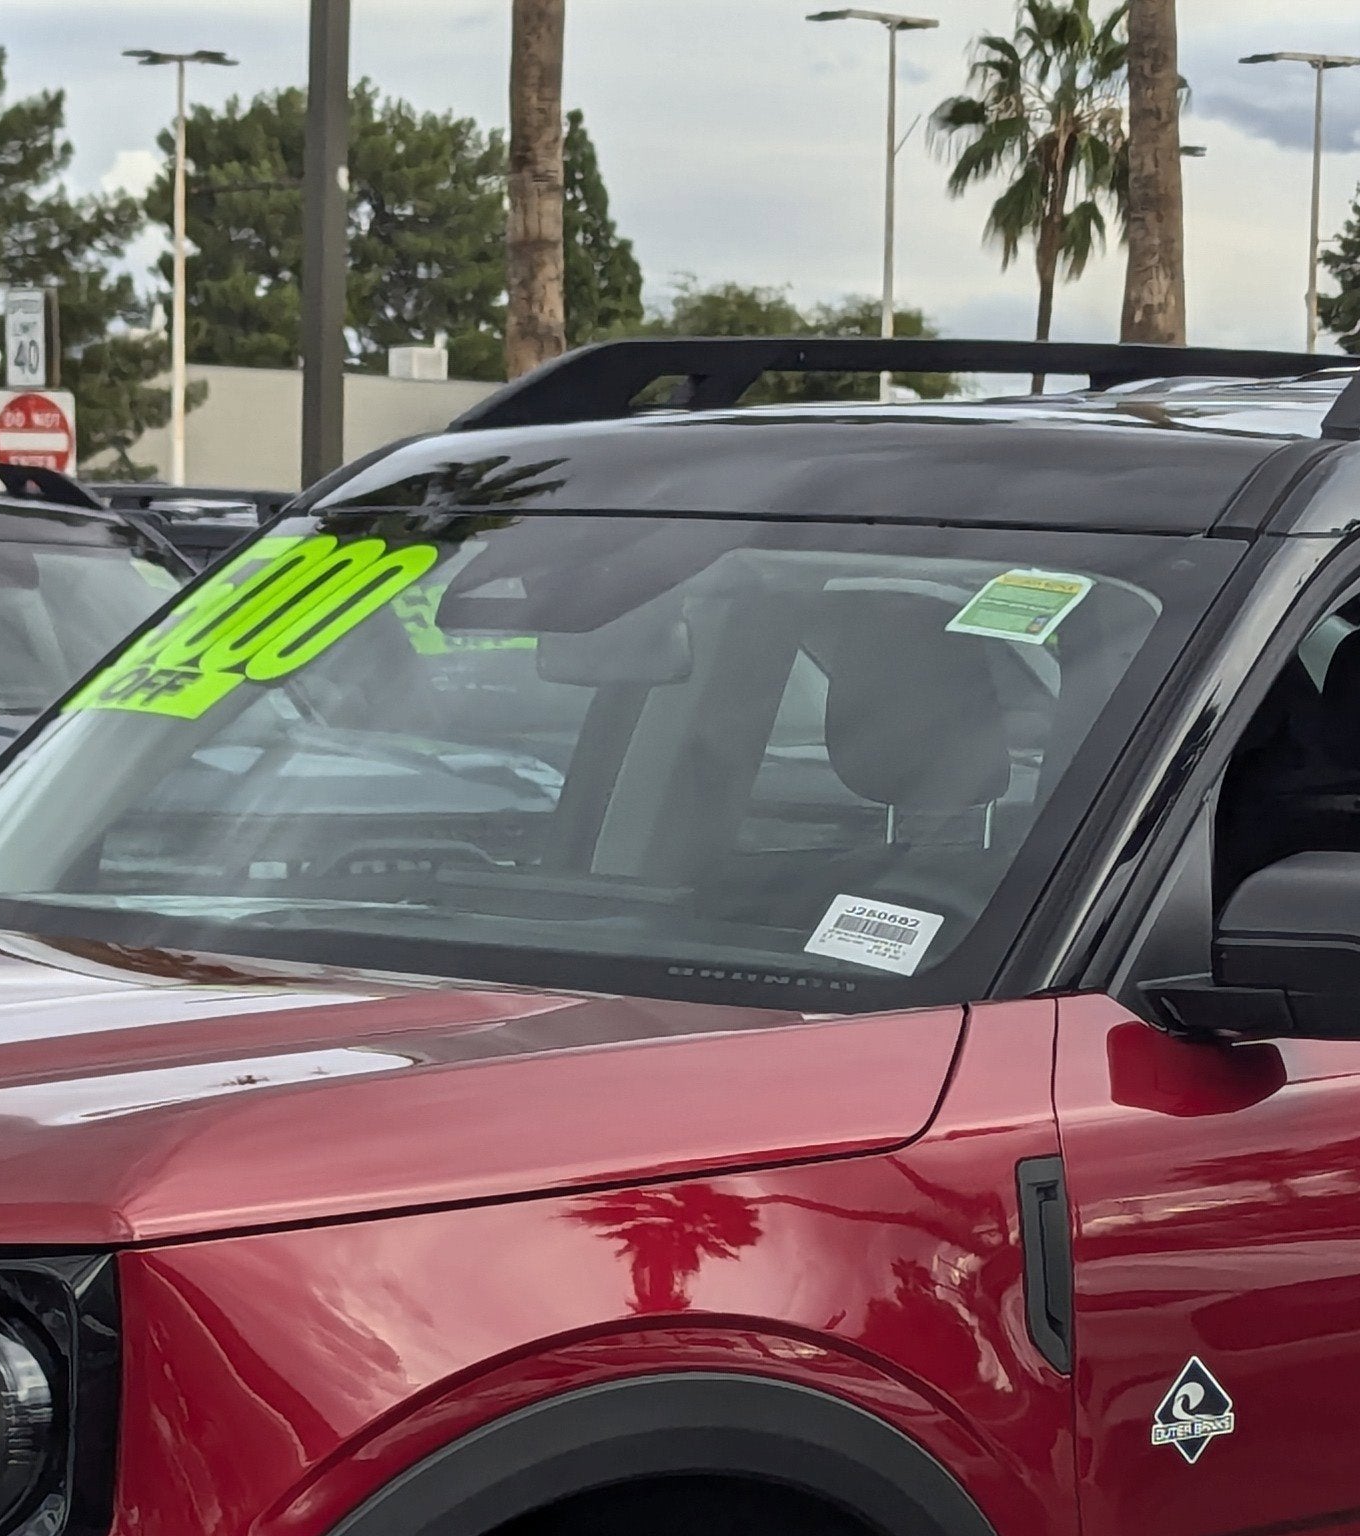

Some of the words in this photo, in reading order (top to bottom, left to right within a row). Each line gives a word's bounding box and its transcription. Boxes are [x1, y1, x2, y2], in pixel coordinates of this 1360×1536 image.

[14, 340, 39, 374] 40
[3, 411, 25, 427] DO
[31, 412, 59, 427] NOT
[99, 667, 203, 706] OFF
